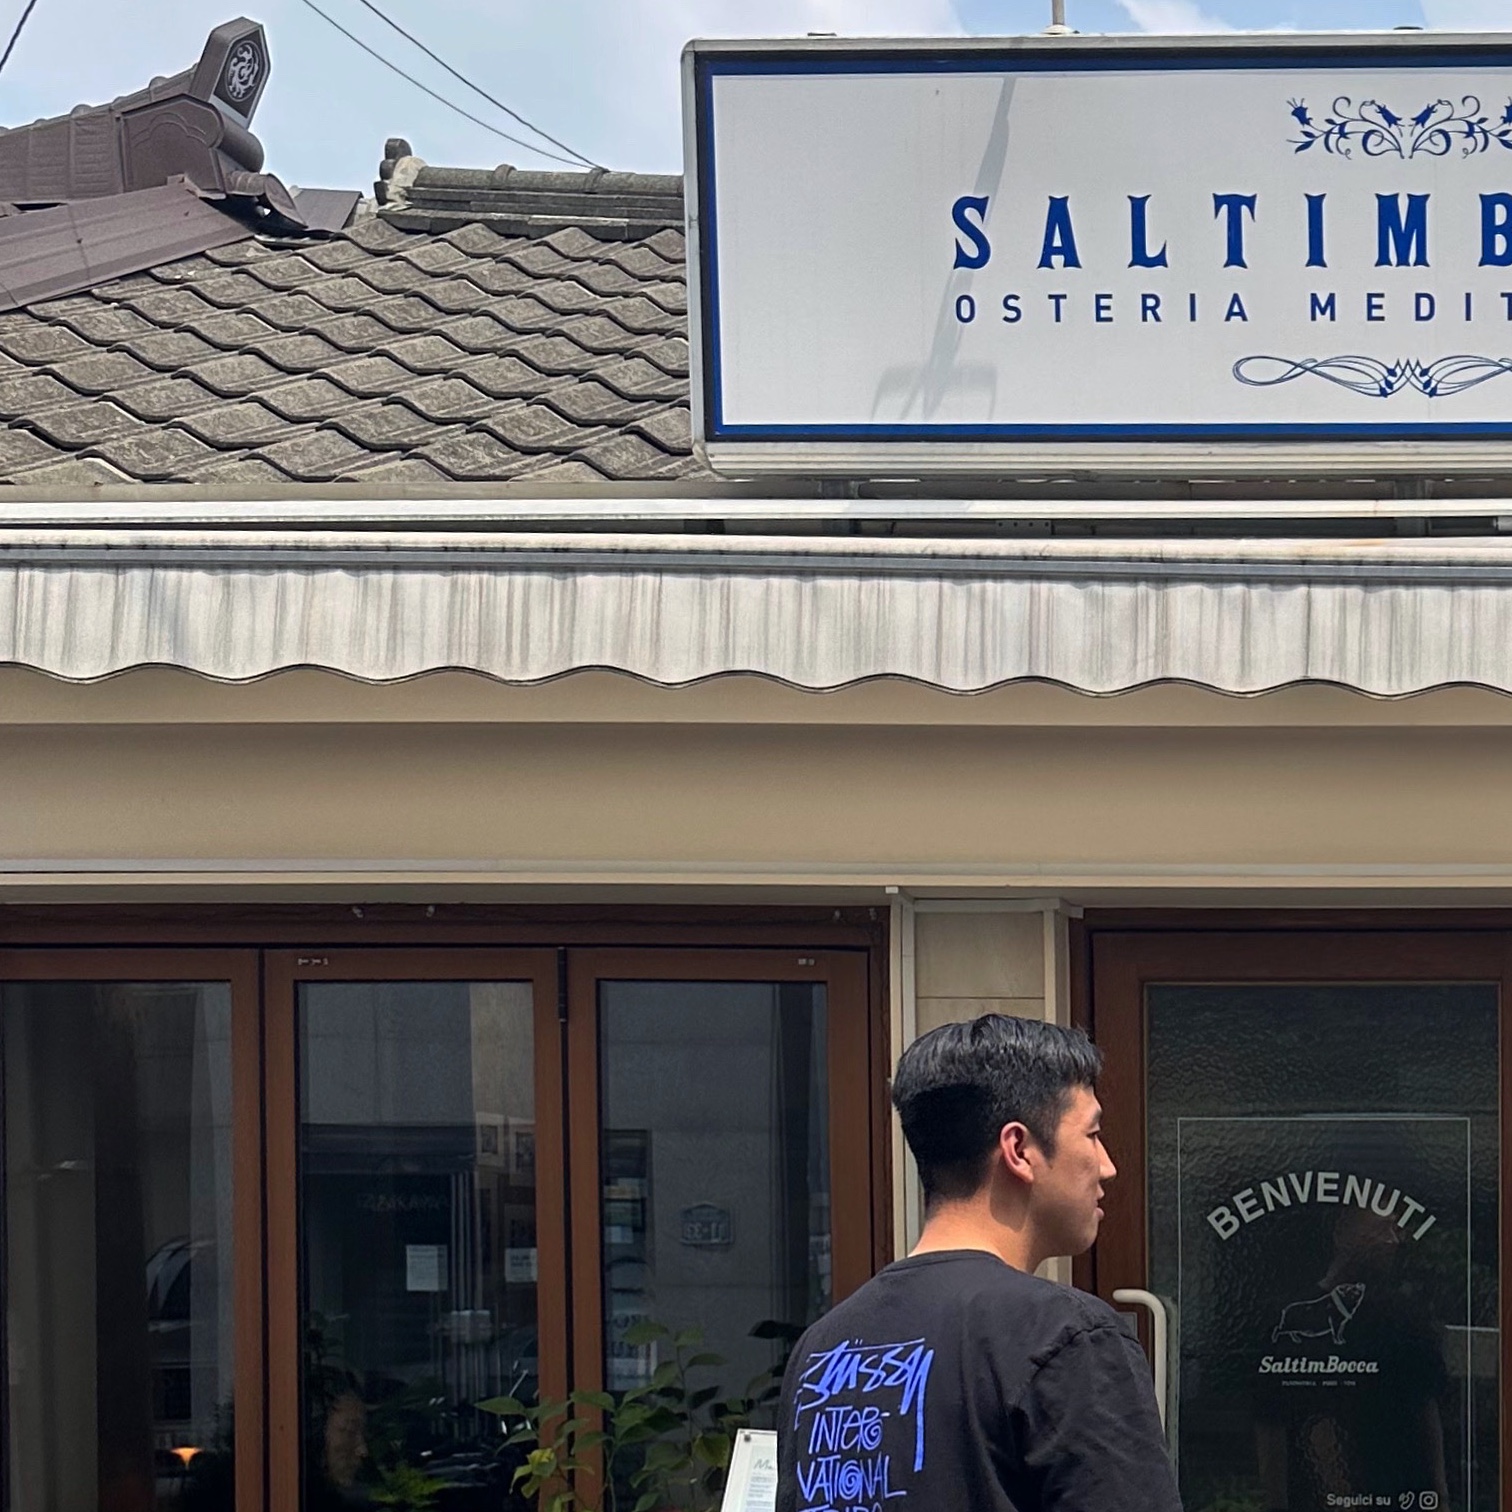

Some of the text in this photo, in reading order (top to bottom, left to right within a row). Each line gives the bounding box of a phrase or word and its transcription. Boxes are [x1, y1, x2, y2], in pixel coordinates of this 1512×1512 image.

[955, 293, 1250, 323] OSTERIA
[1206, 1170, 1437, 1241] BENVENUTI
[1258, 1354, 1380, 1375] SaltimBocca
[1375, 1495, 1392, 1506] su
